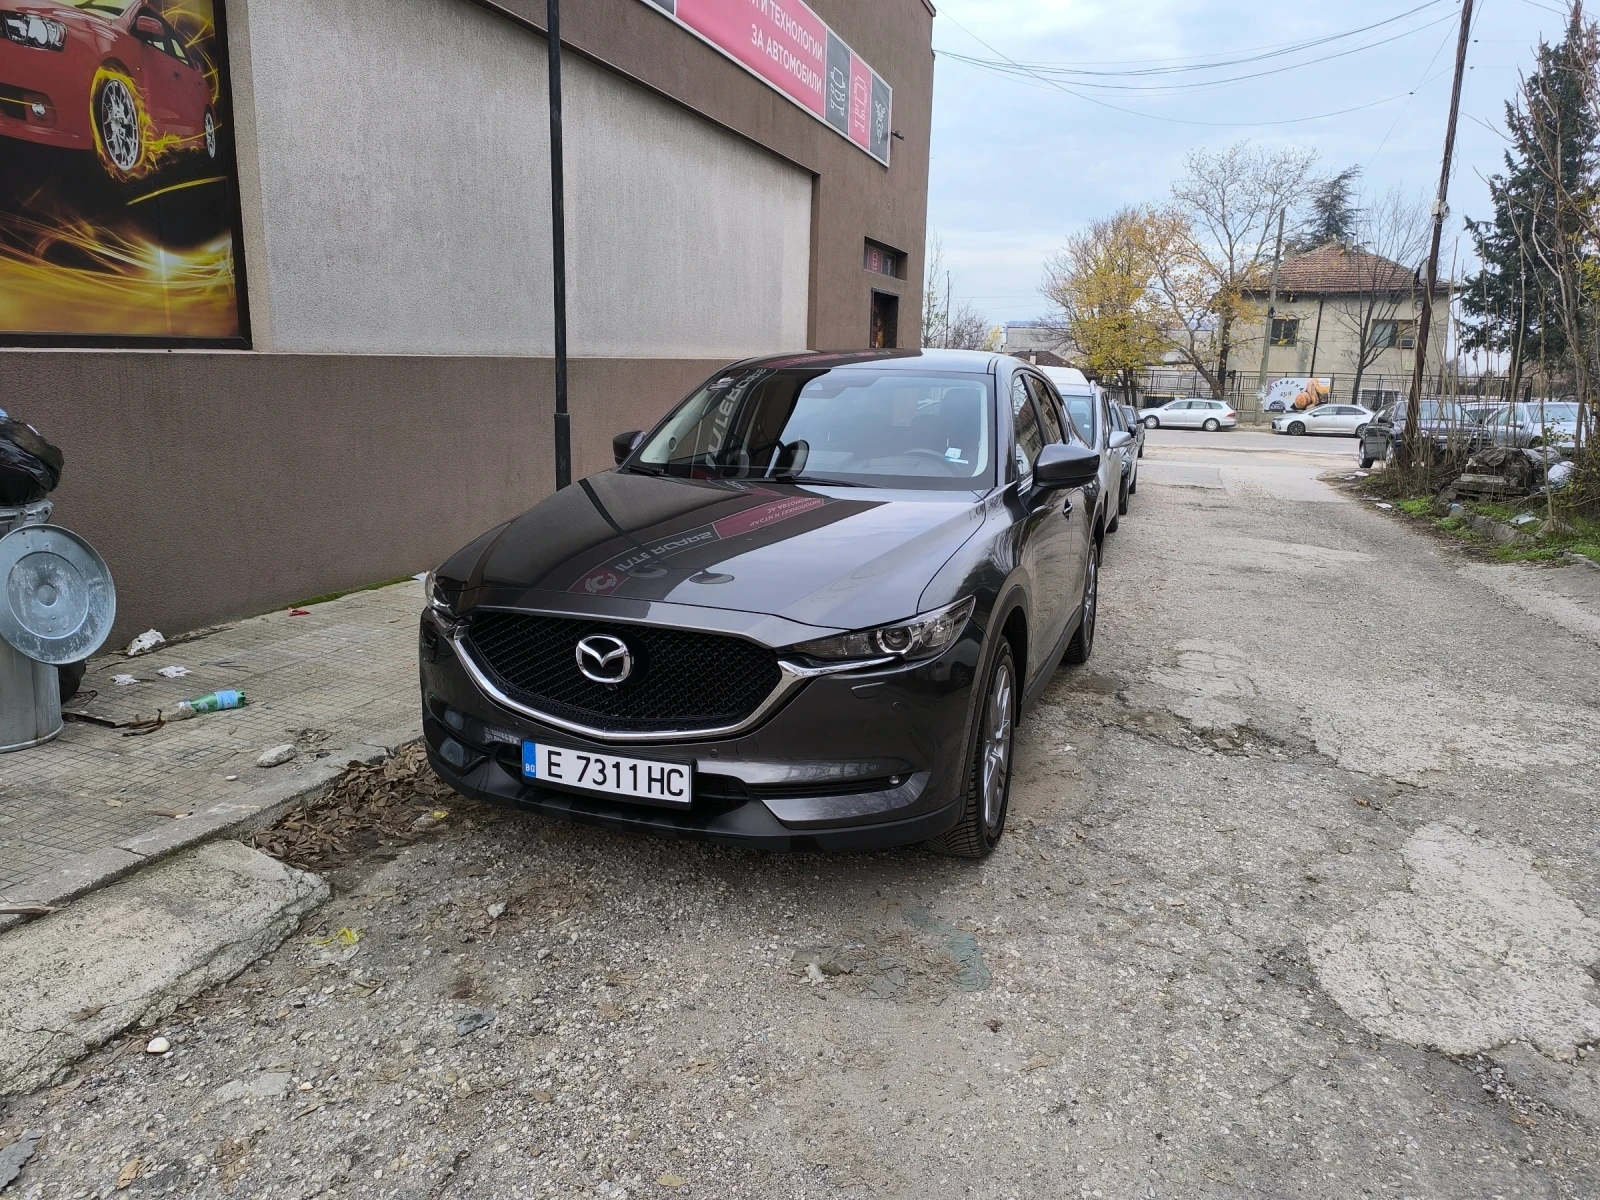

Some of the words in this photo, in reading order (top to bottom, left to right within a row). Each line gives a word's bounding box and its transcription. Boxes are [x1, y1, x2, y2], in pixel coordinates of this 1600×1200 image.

[769, 0, 823, 63] ТЕХНОЛОГИИ
[751, 23, 764, 52] ЗА
[766, 36, 822, 95] АВТОМОБИЛИ
[525, 763, 536, 773] BG
[547, 749, 563, 779] E
